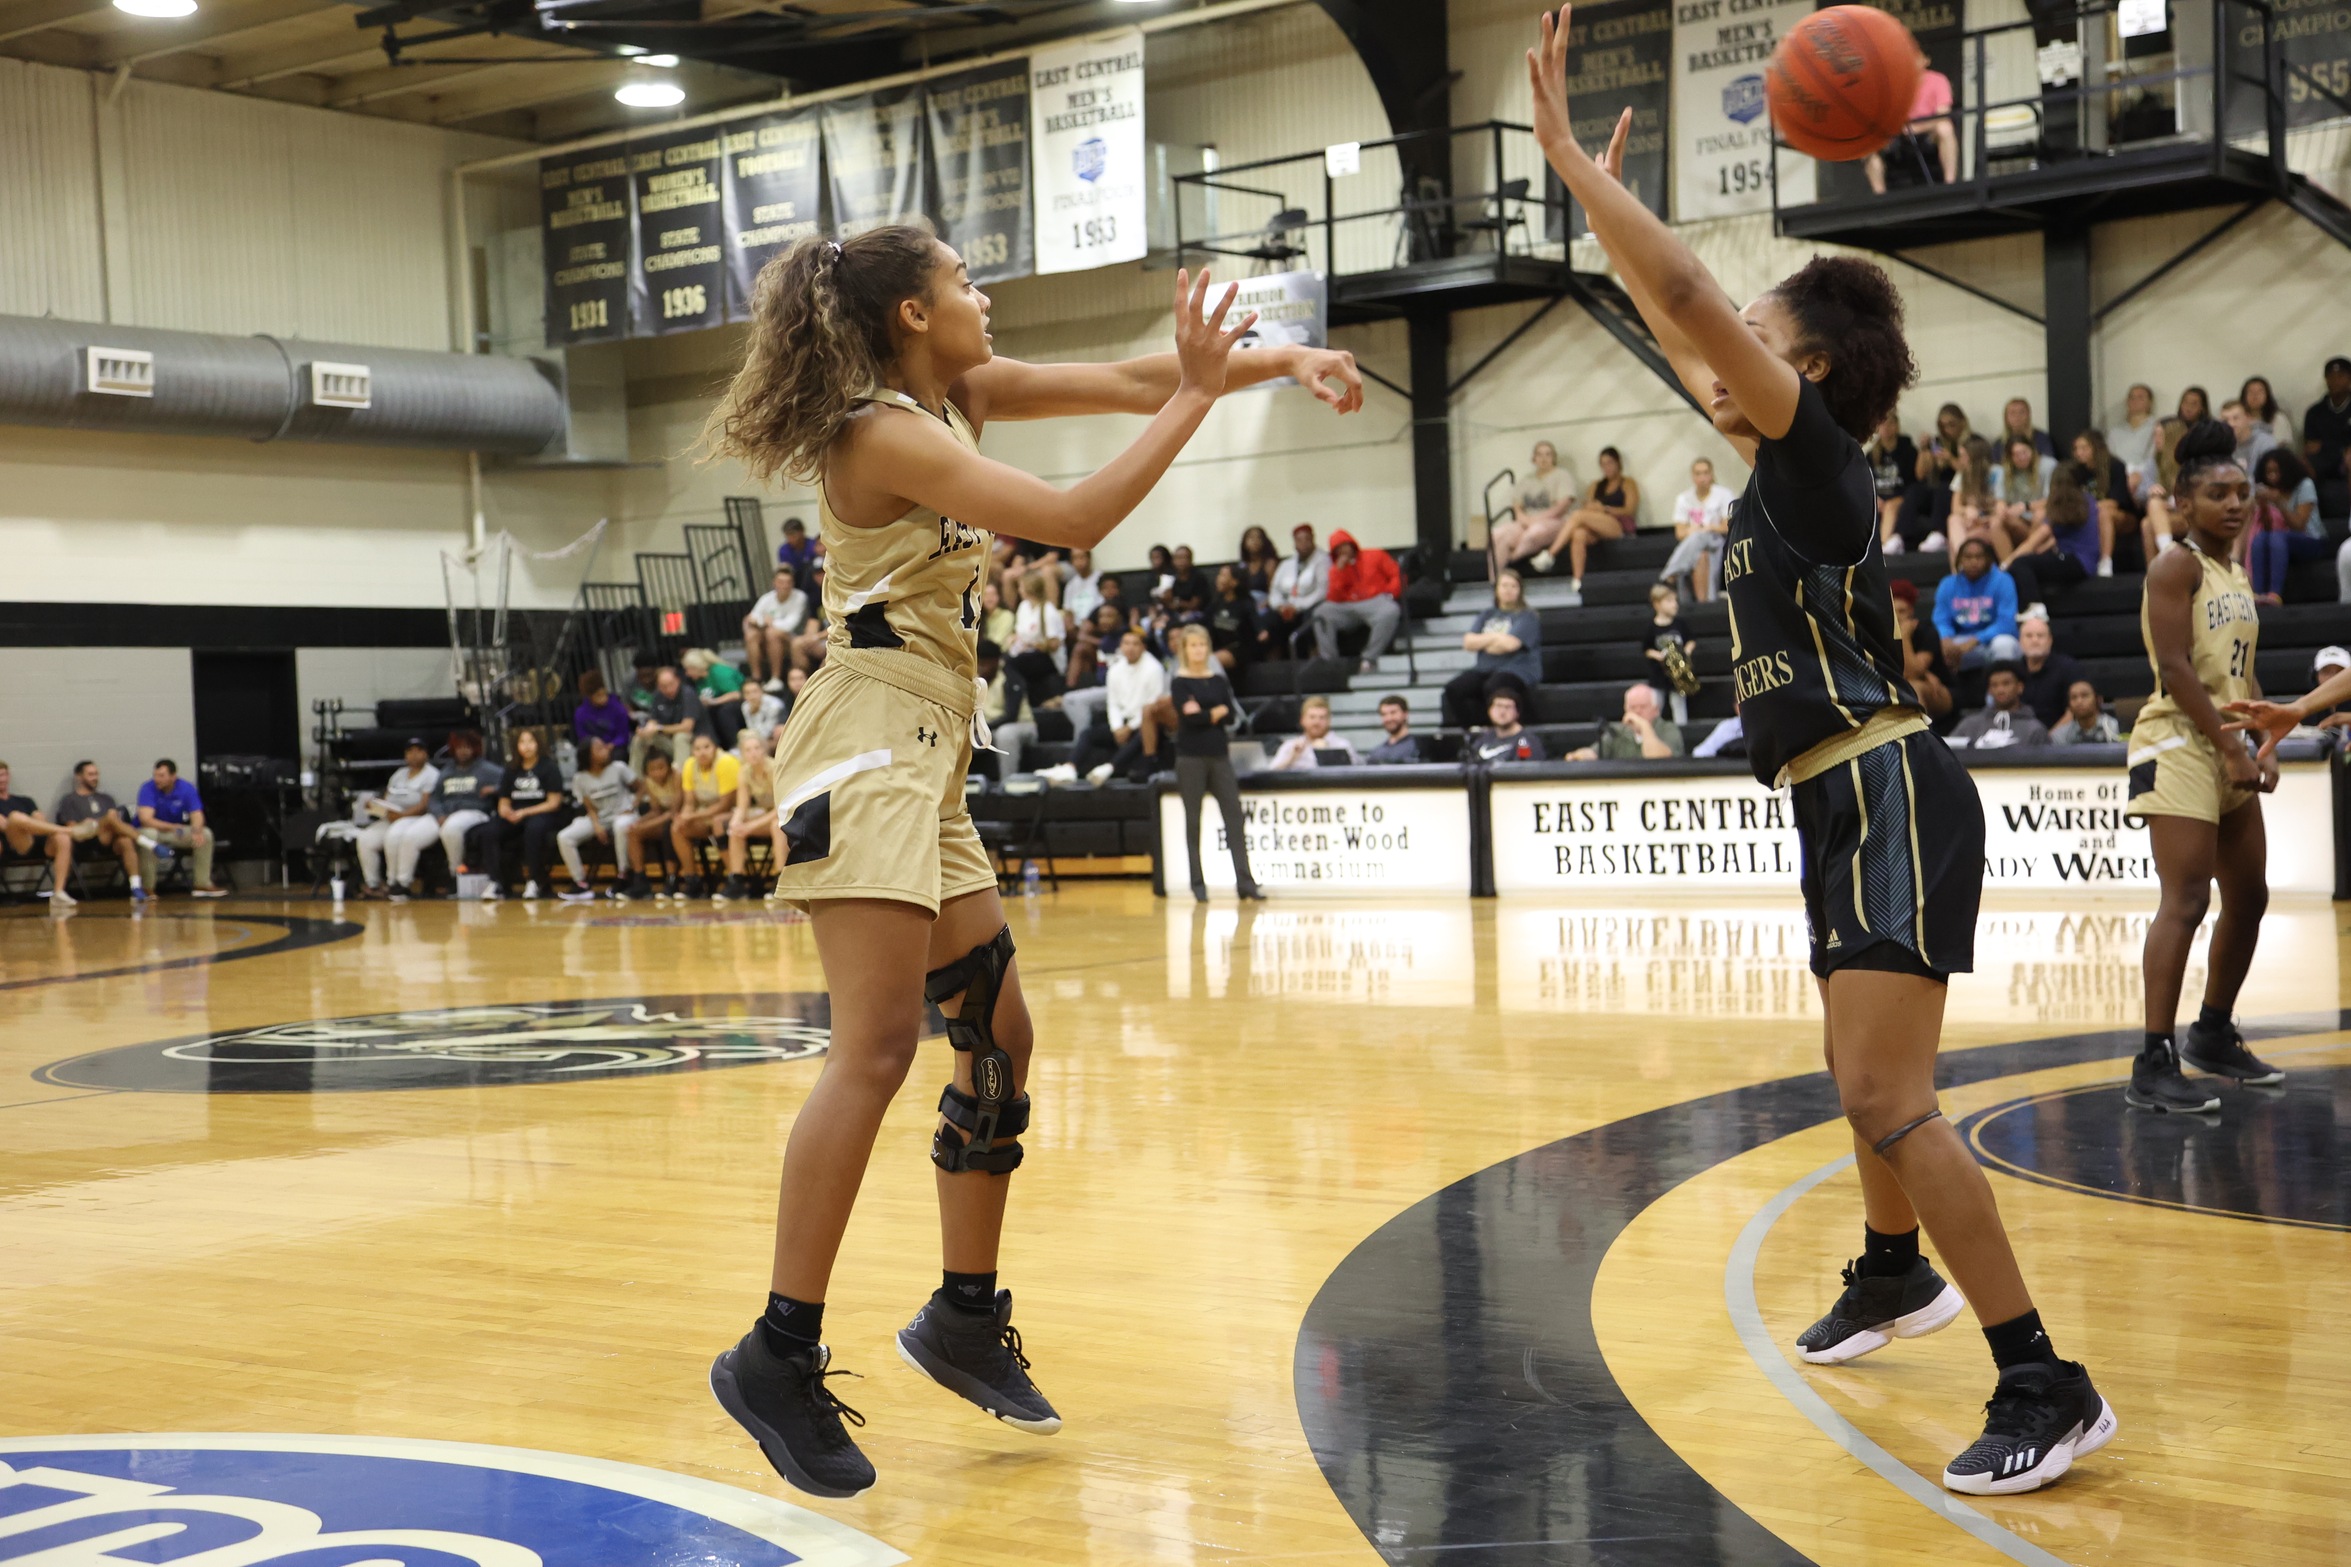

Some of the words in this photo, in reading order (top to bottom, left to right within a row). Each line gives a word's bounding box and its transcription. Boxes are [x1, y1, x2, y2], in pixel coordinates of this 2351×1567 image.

[1592, 9, 1670, 42] CENTRAL
[1678, 1, 1720, 25] EAST
[1717, 19, 1773, 44] MEN'S
[1036, 65, 1070, 88] EAST
[1076, 52, 1144, 79] CENTRAL
[1688, 40, 1777, 72] BASKETB
[1067, 86, 1113, 109] MEN'S
[1045, 102, 1136, 134] BASKETBALL
[1696, 130, 1744, 155] FINAL
[1749, 127, 1773, 145] FO
[1073, 215, 1117, 249] 1953
[962, 232, 1009, 268] 1953
[662, 284, 707, 319] 1936
[960, 563, 982, 630] 1
[2207, 592, 2236, 631] EAST
[2230, 638, 2250, 678] 21
[1733, 650, 1794, 704] IGERS
[2030, 785, 2085, 801] Home
[2098, 784, 2118, 800] Of
[1240, 800, 1346, 825] Welcome
[1361, 800, 1384, 823] to
[1533, 801, 1618, 833] EAST
[2002, 804, 2148, 832] WARRIO
[1217, 826, 1409, 851] Backeen-Wood
[2079, 833, 2116, 849] and
[1256, 855, 1385, 879] ymnasium
[1555, 842, 1792, 875] BASKETBALL
[1984, 856, 2037, 878] ADY
